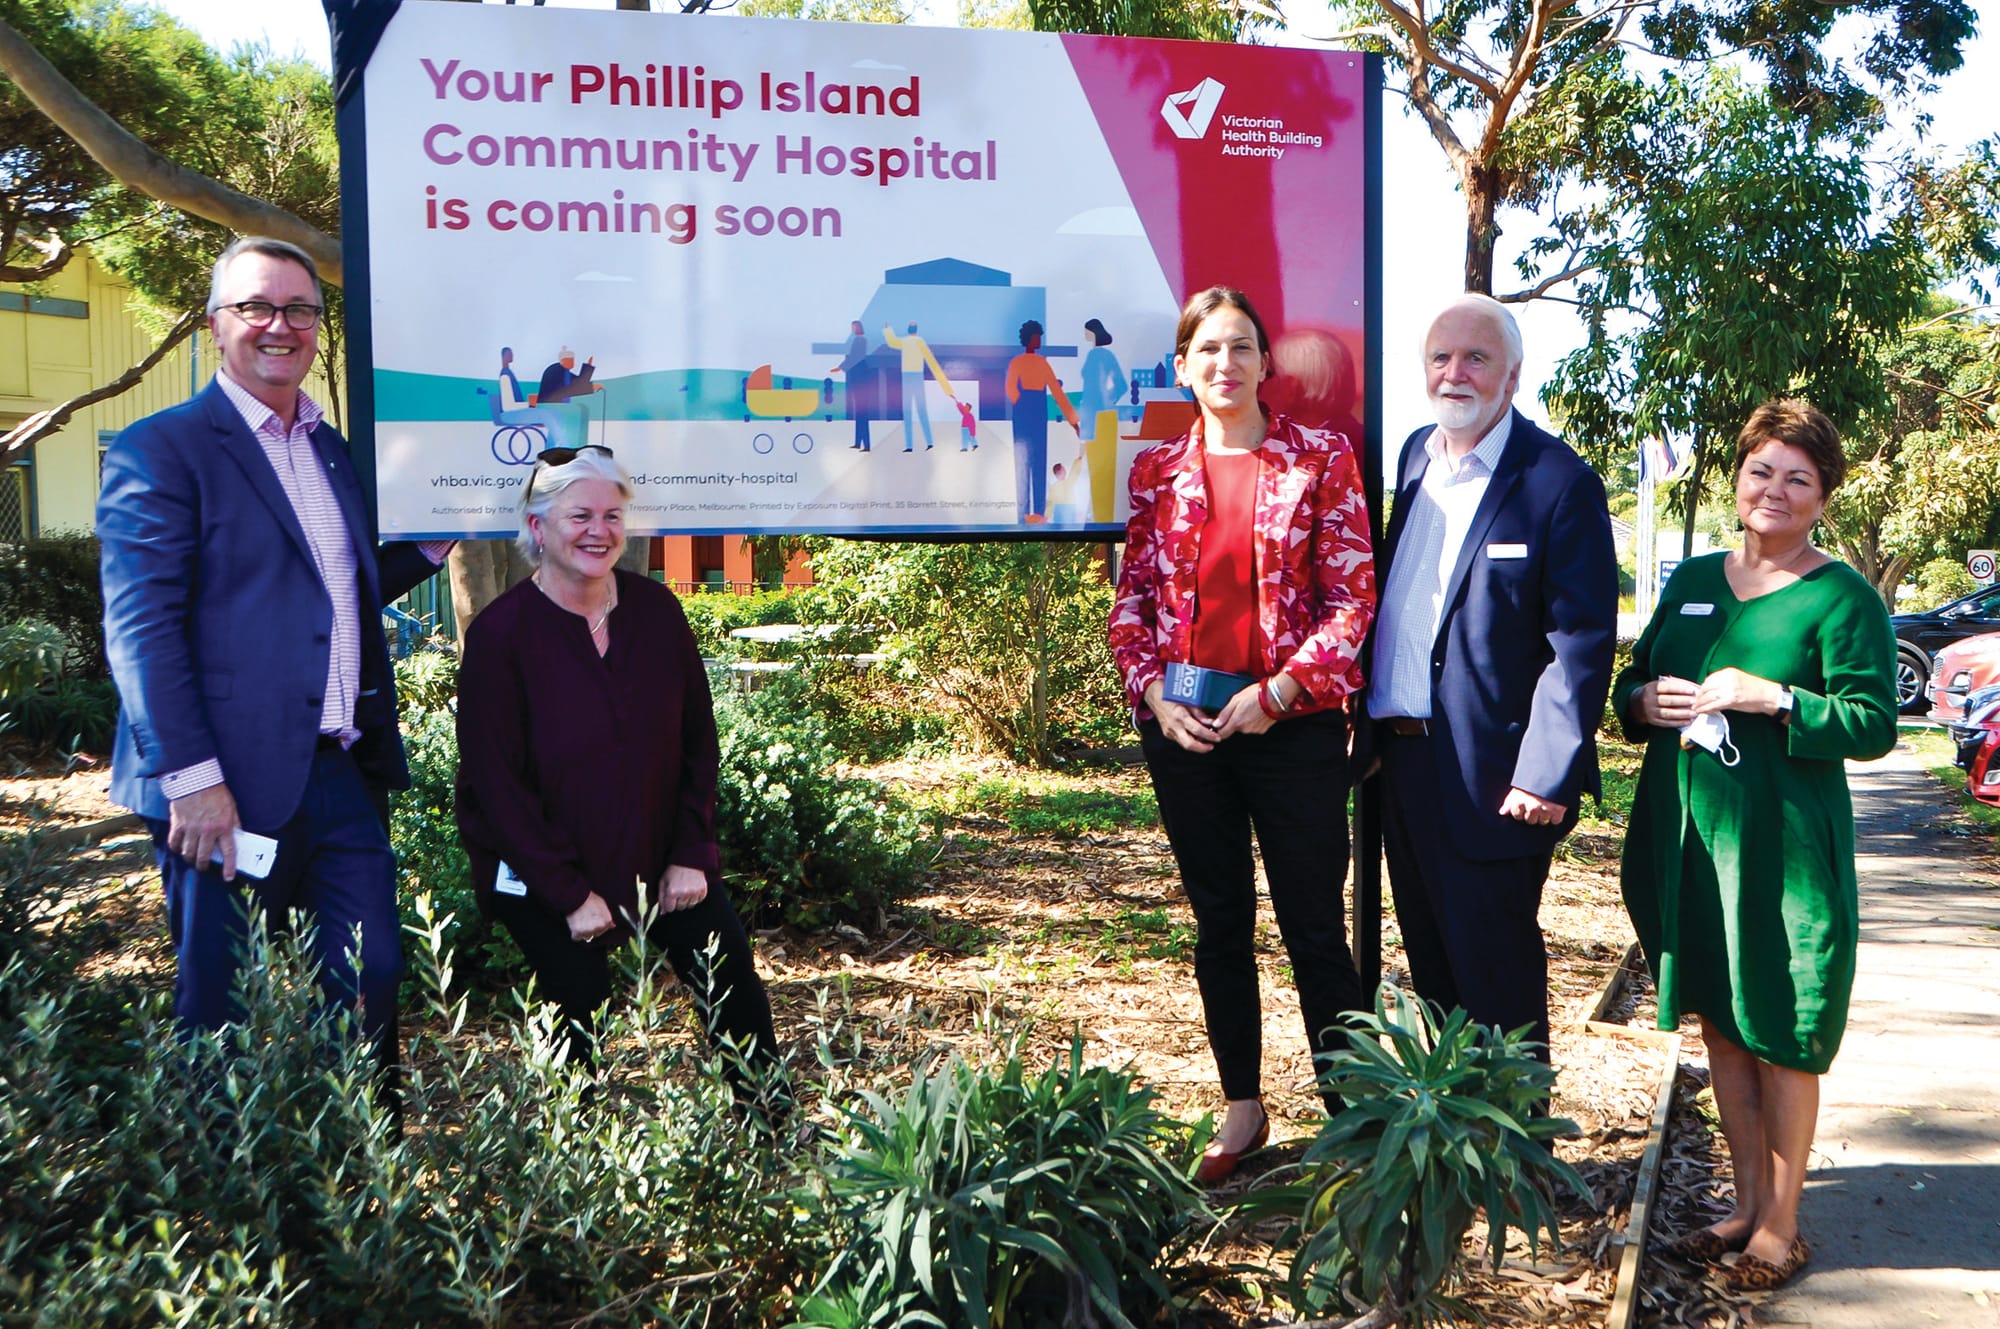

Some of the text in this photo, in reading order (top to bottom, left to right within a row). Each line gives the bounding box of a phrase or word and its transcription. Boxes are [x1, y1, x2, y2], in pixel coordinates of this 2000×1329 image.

[422, 59, 920, 119] Your Phillip Island
[1222, 115, 1283, 129] Victorian
[1222, 130, 1322, 147] Health Building
[424, 124, 996, 187] Community Hospital
[1222, 144, 1284, 159] Authority
[426, 186, 842, 244] is coming soon
[431, 472, 798, 489] vhba.vic.gov nd-community-hospital
[431, 505, 482, 515] Authorised
[485, 505, 496, 516] by
[498, 505, 514, 514] the
[629, 503, 667, 512] Treasury
[750, 502, 782, 511] Printed
[784, 502, 795, 511] by
[797, 502, 838, 511] Exposure
[840, 501, 868, 511] Digital
[1973, 562, 1989, 572] 60
[1182, 666, 1196, 698] COV
